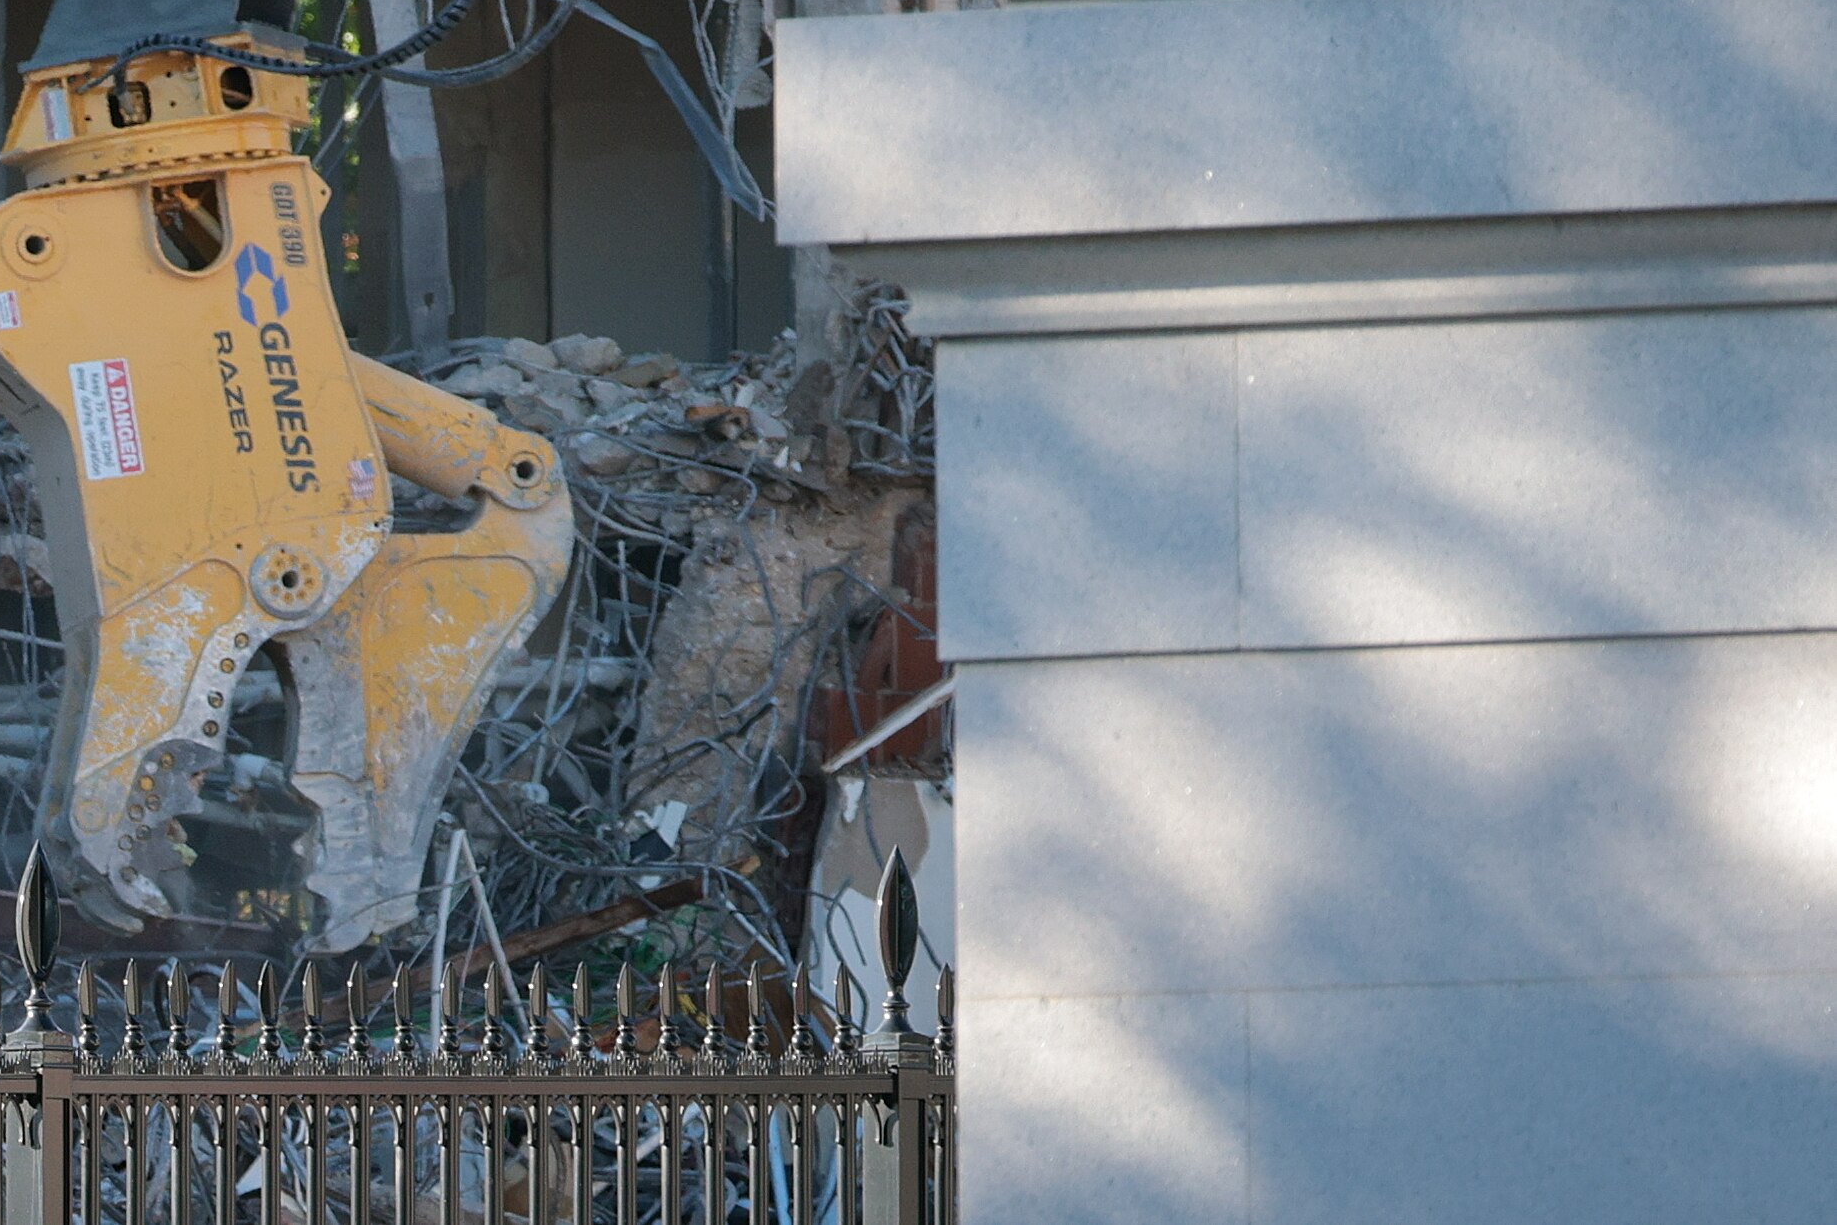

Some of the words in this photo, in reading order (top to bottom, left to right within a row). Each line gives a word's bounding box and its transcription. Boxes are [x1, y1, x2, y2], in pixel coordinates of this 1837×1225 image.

[278, 223, 308, 267] 390
[110, 386, 139, 468] DANGER
[214, 331, 253, 455] RAZER
[261, 322, 316, 493] GENESIS
